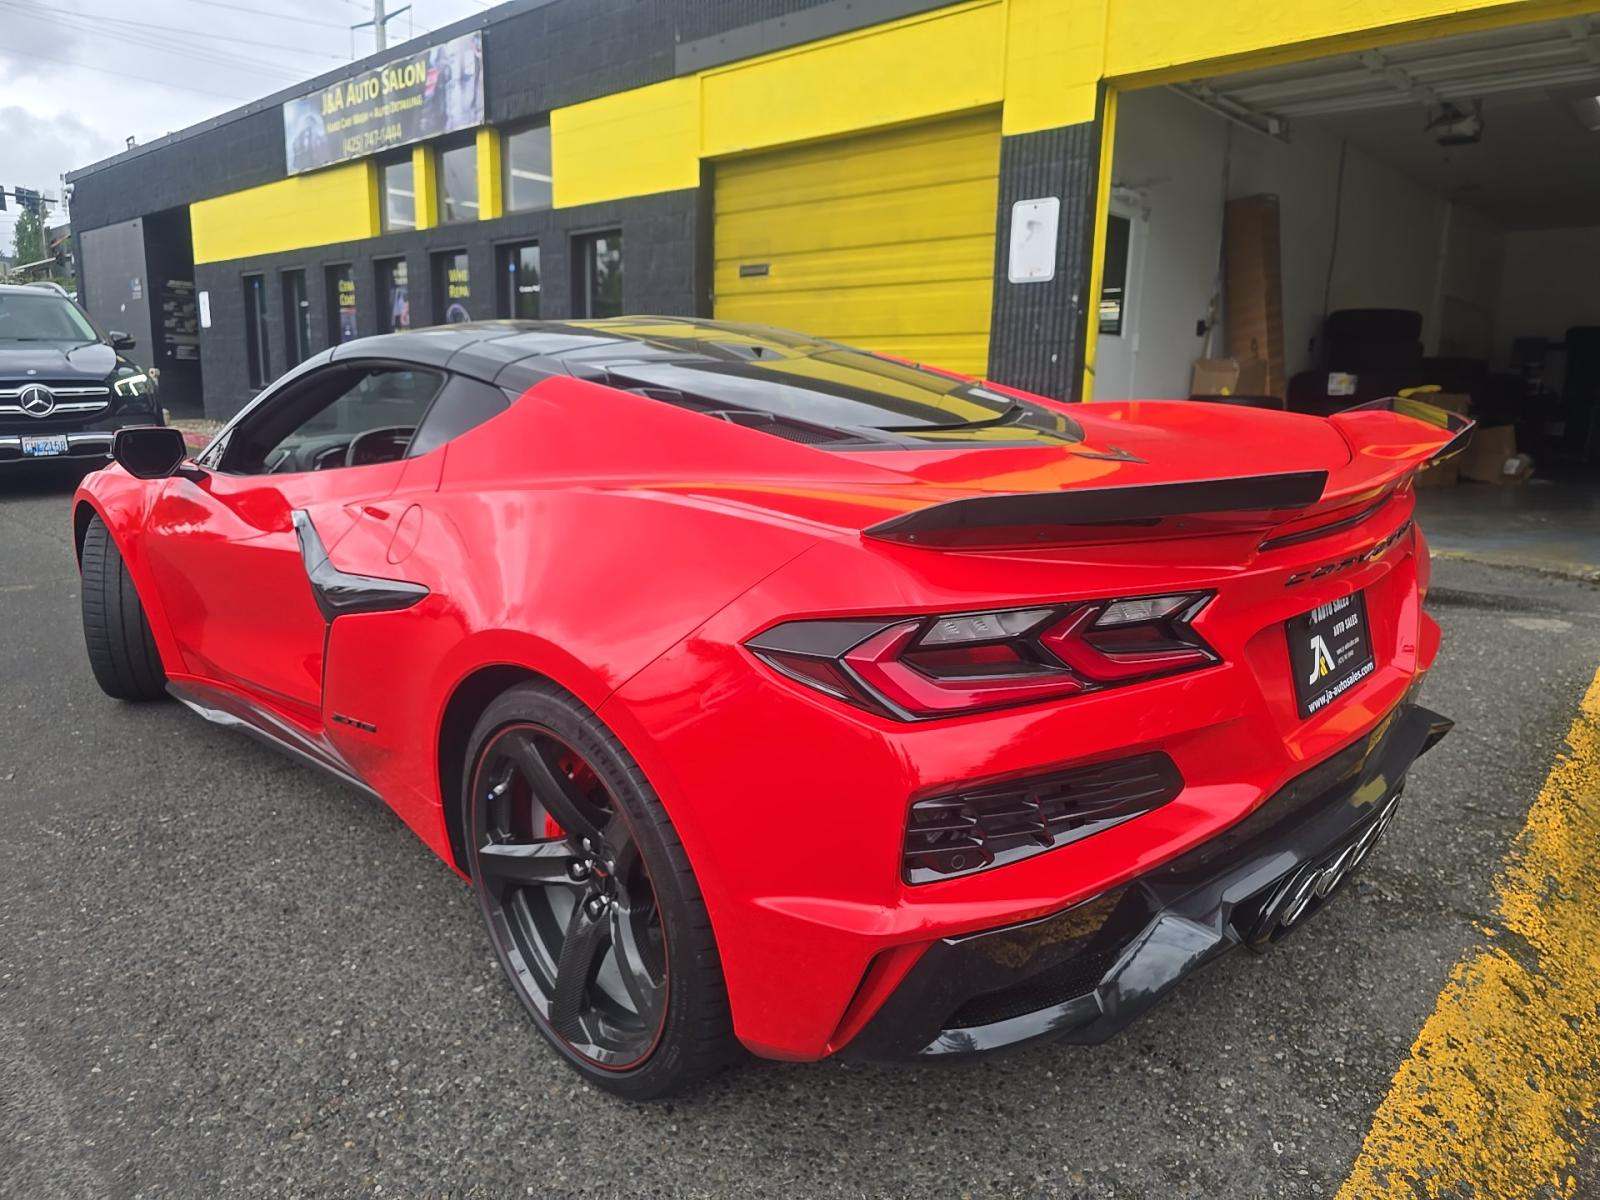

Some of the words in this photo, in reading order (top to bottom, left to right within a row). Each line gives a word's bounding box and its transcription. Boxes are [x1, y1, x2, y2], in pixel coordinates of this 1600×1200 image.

[322, 87, 344, 116] J&A
[1333, 621, 1345, 637] AUTO
[1344, 613, 1358, 630] SALES
[1308, 660, 1374, 713] www.ja-autosales.com
